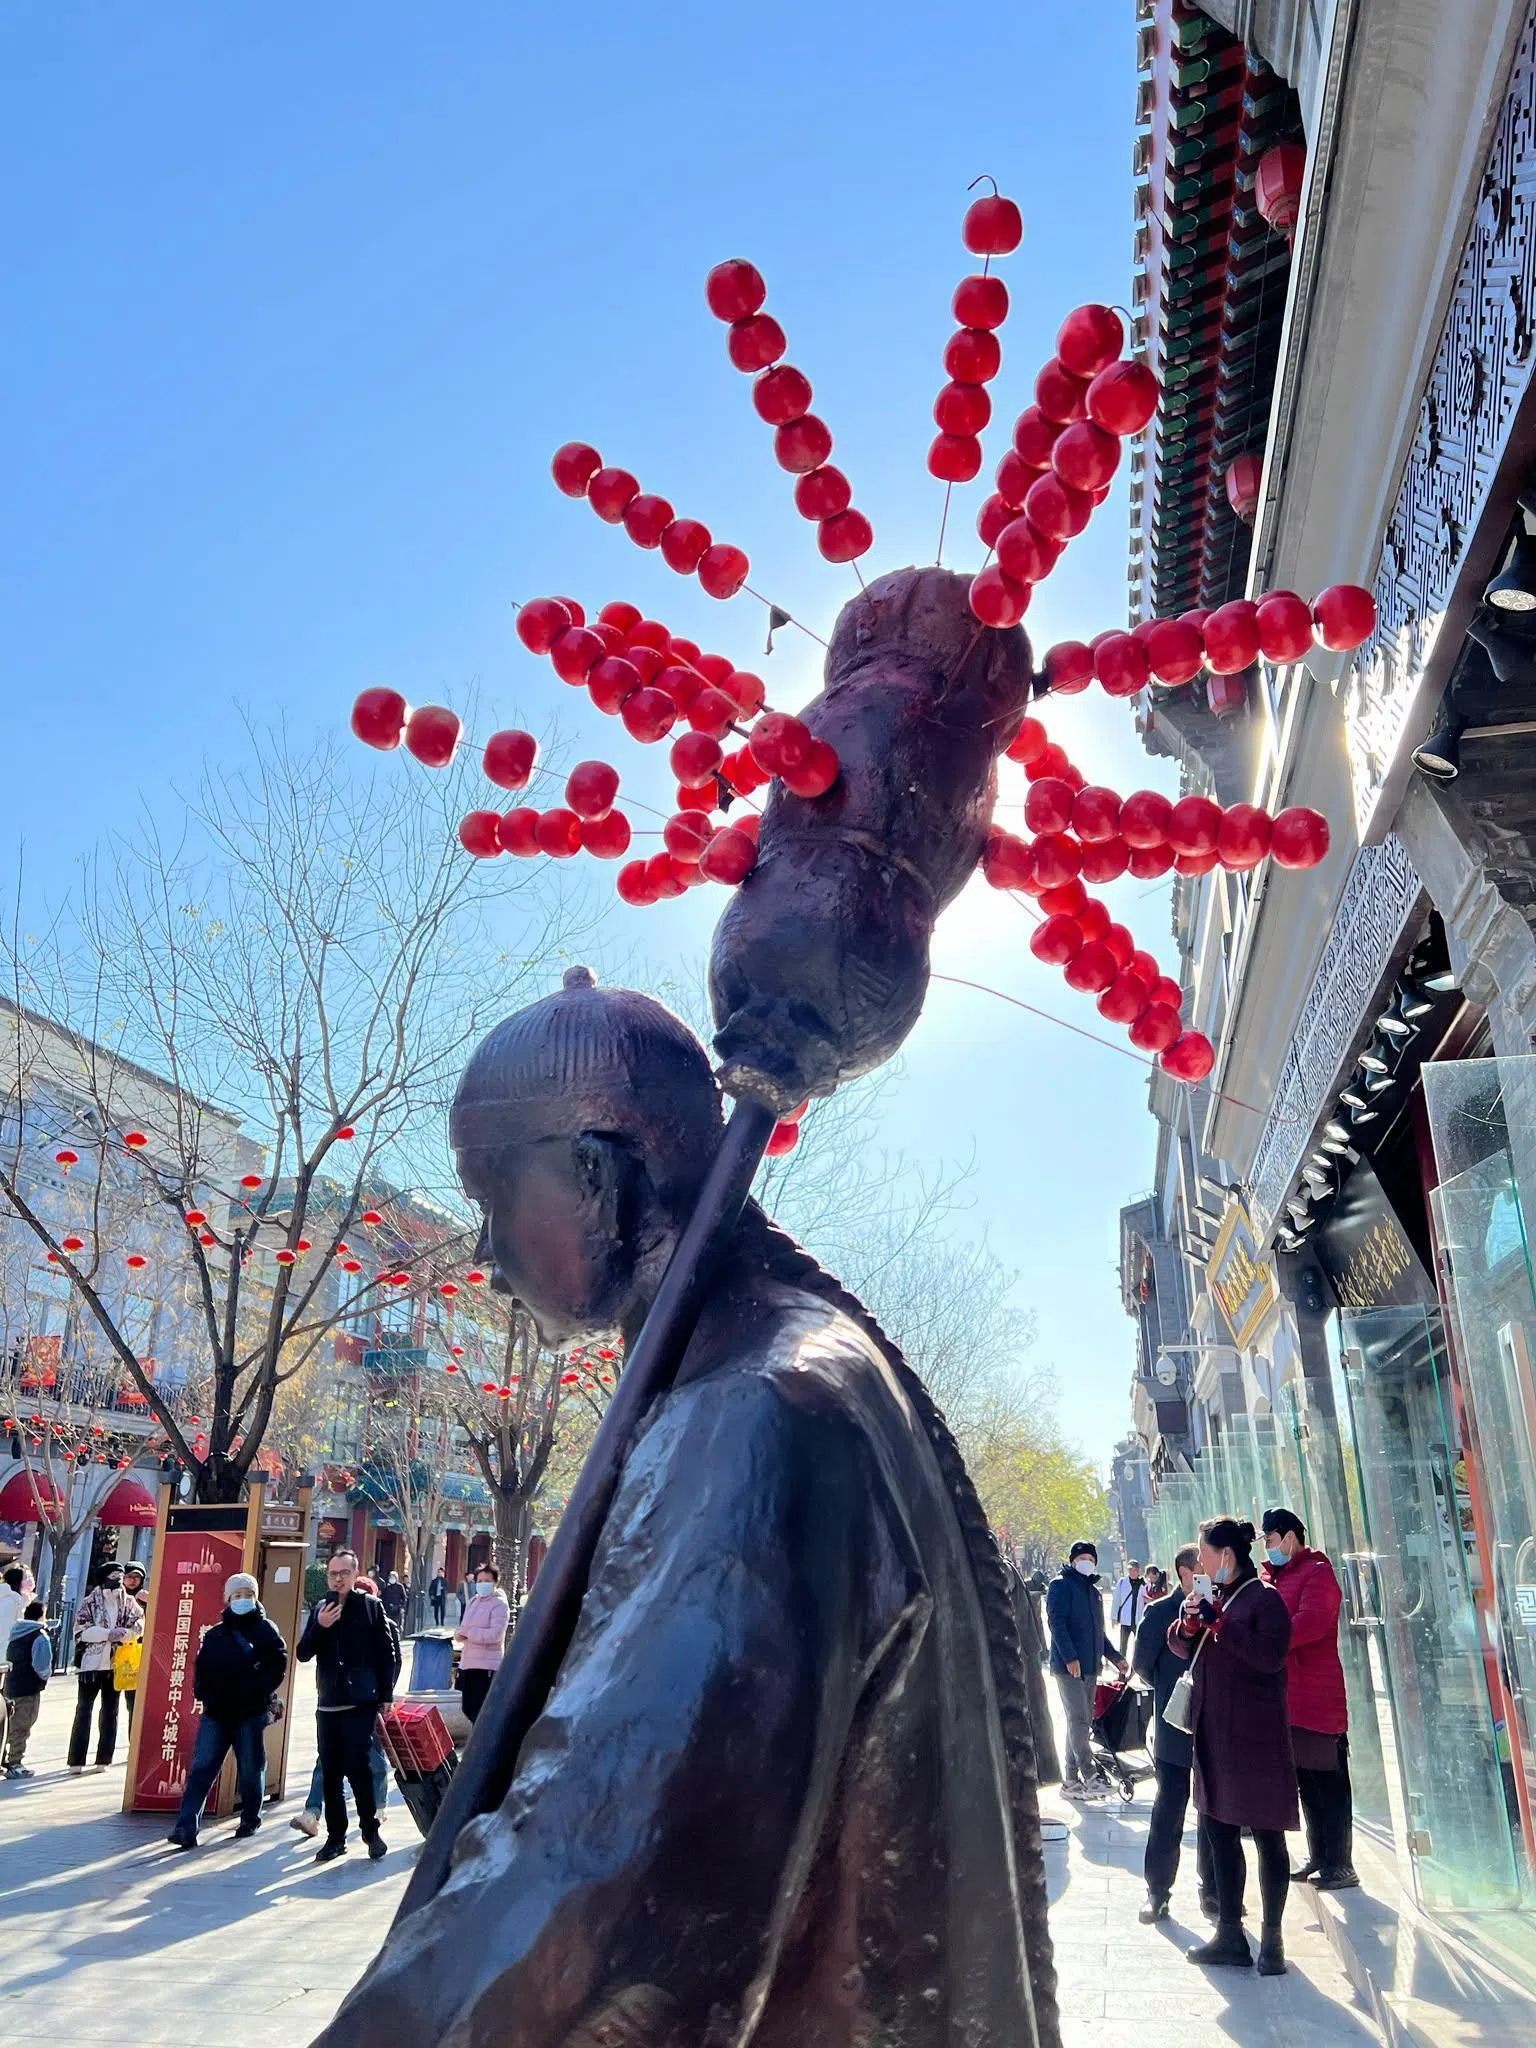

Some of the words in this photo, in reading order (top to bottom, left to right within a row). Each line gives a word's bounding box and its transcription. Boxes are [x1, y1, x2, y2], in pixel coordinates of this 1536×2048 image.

[161, 1581, 194, 1761] 中国国际消费中心城市
